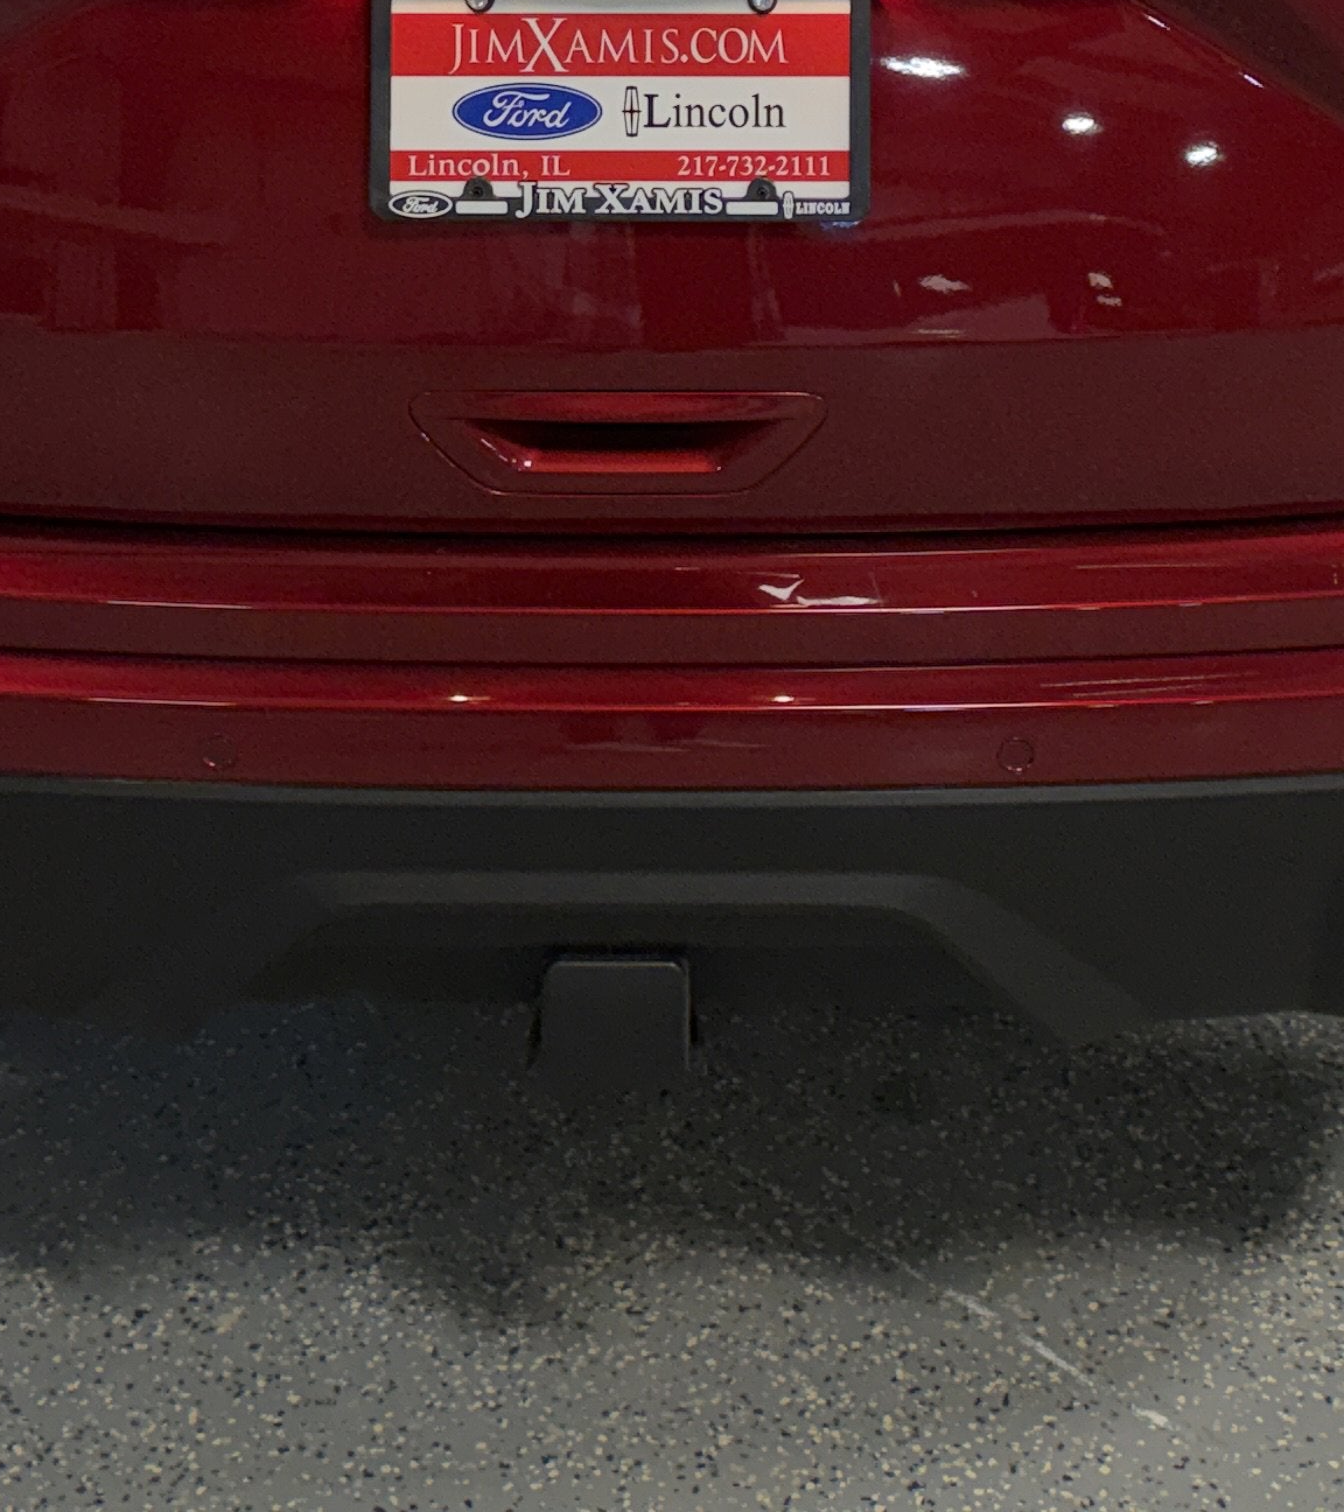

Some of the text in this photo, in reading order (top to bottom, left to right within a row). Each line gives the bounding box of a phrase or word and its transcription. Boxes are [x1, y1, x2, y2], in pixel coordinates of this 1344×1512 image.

[449, 17, 789, 75] JIMXAMIS.COM
[482, 90, 570, 129] Ford
[644, 93, 785, 129] Lincoln
[408, 153, 571, 179] Lincoln, IL
[677, 155, 830, 177] 217-732-2111
[402, 196, 439, 213] Ford
[515, 181, 723, 218] JIM XAMIS
